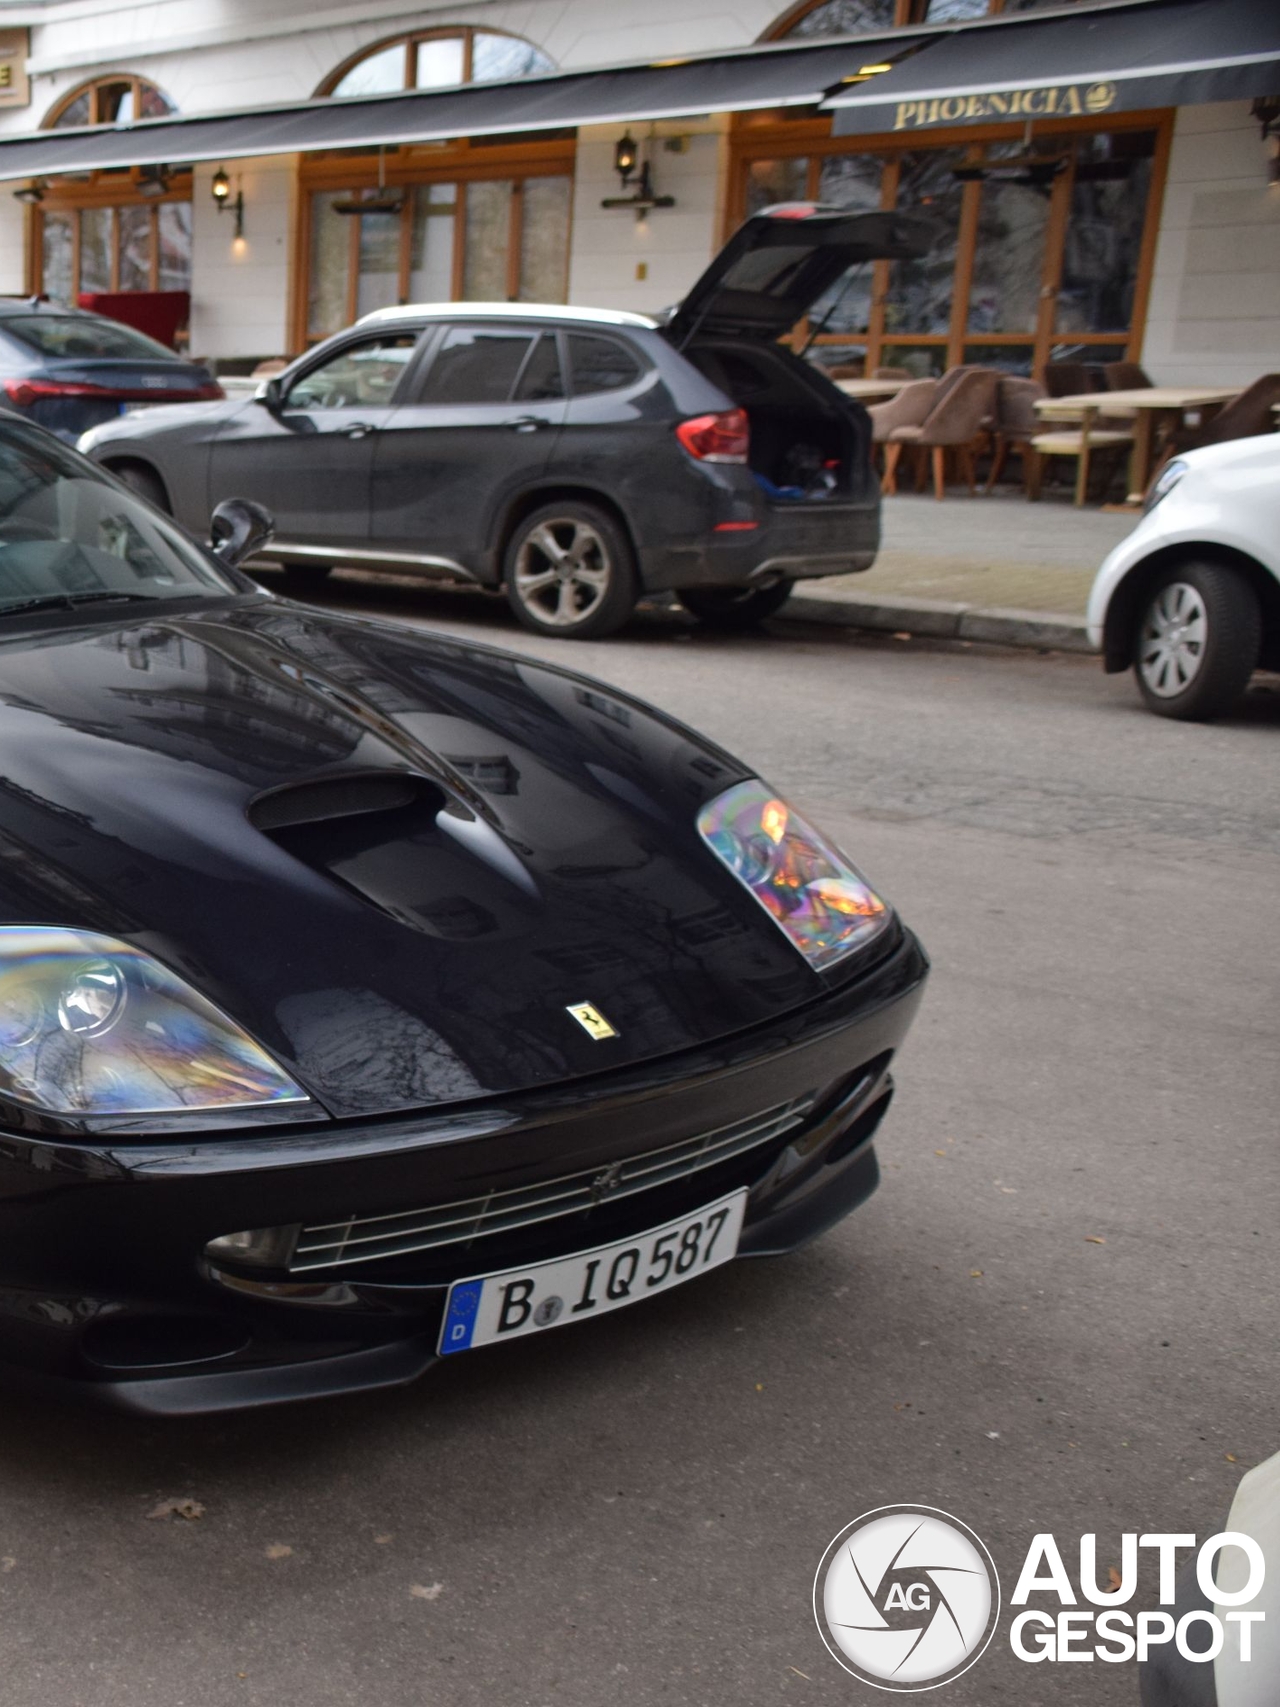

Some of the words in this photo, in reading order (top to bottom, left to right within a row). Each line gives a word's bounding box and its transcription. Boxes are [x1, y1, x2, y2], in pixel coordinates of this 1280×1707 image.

[893, 85, 1083, 131] PHOENICIA
[497, 1278, 535, 1333] B
[451, 1323, 465, 1341] D
